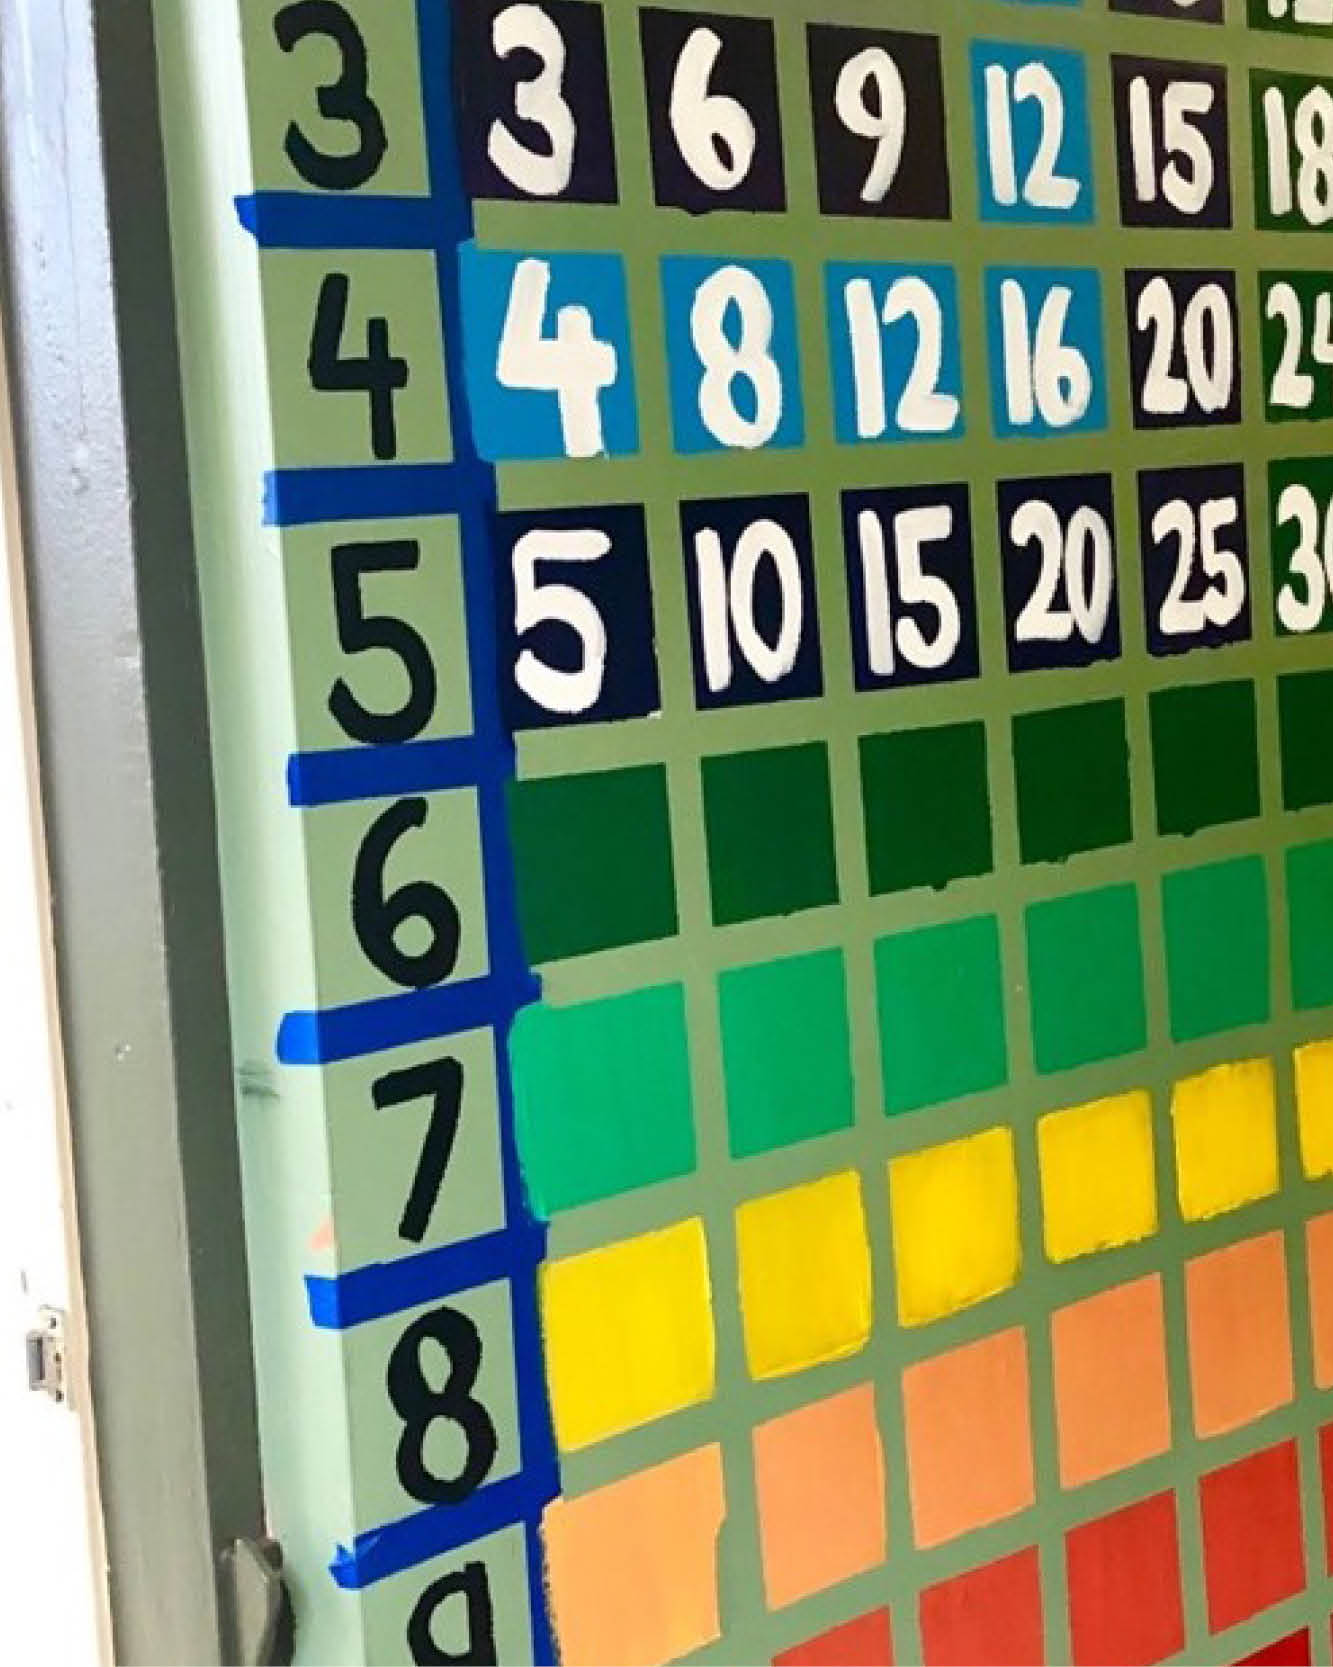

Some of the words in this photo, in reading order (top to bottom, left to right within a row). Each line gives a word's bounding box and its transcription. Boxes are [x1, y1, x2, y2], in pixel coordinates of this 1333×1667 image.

[274, 0, 388, 190] 3
[488, 4, 575, 195] 3
[669, 28, 755, 190] 6
[836, 47, 906, 201] 9
[985, 63, 1079, 209] 12
[1130, 76, 1214, 213] 15
[307, 273, 409, 460] 4
[496, 259, 617, 458] 4
[690, 265, 782, 449] 8
[844, 276, 960, 438] 12
[1001, 279, 1092, 427] 16
[1138, 277, 1233, 414] 20
[328, 540, 437, 746] 5
[512, 530, 612, 713] 5
[695, 519, 801, 692] 10
[858, 506, 960, 675] 15
[1011, 500, 1111, 643] 20
[1152, 496, 1244, 635] 25
[353, 797, 461, 990] 6
[372, 1056, 463, 1242] 7
[388, 1307, 498, 1507] 8
